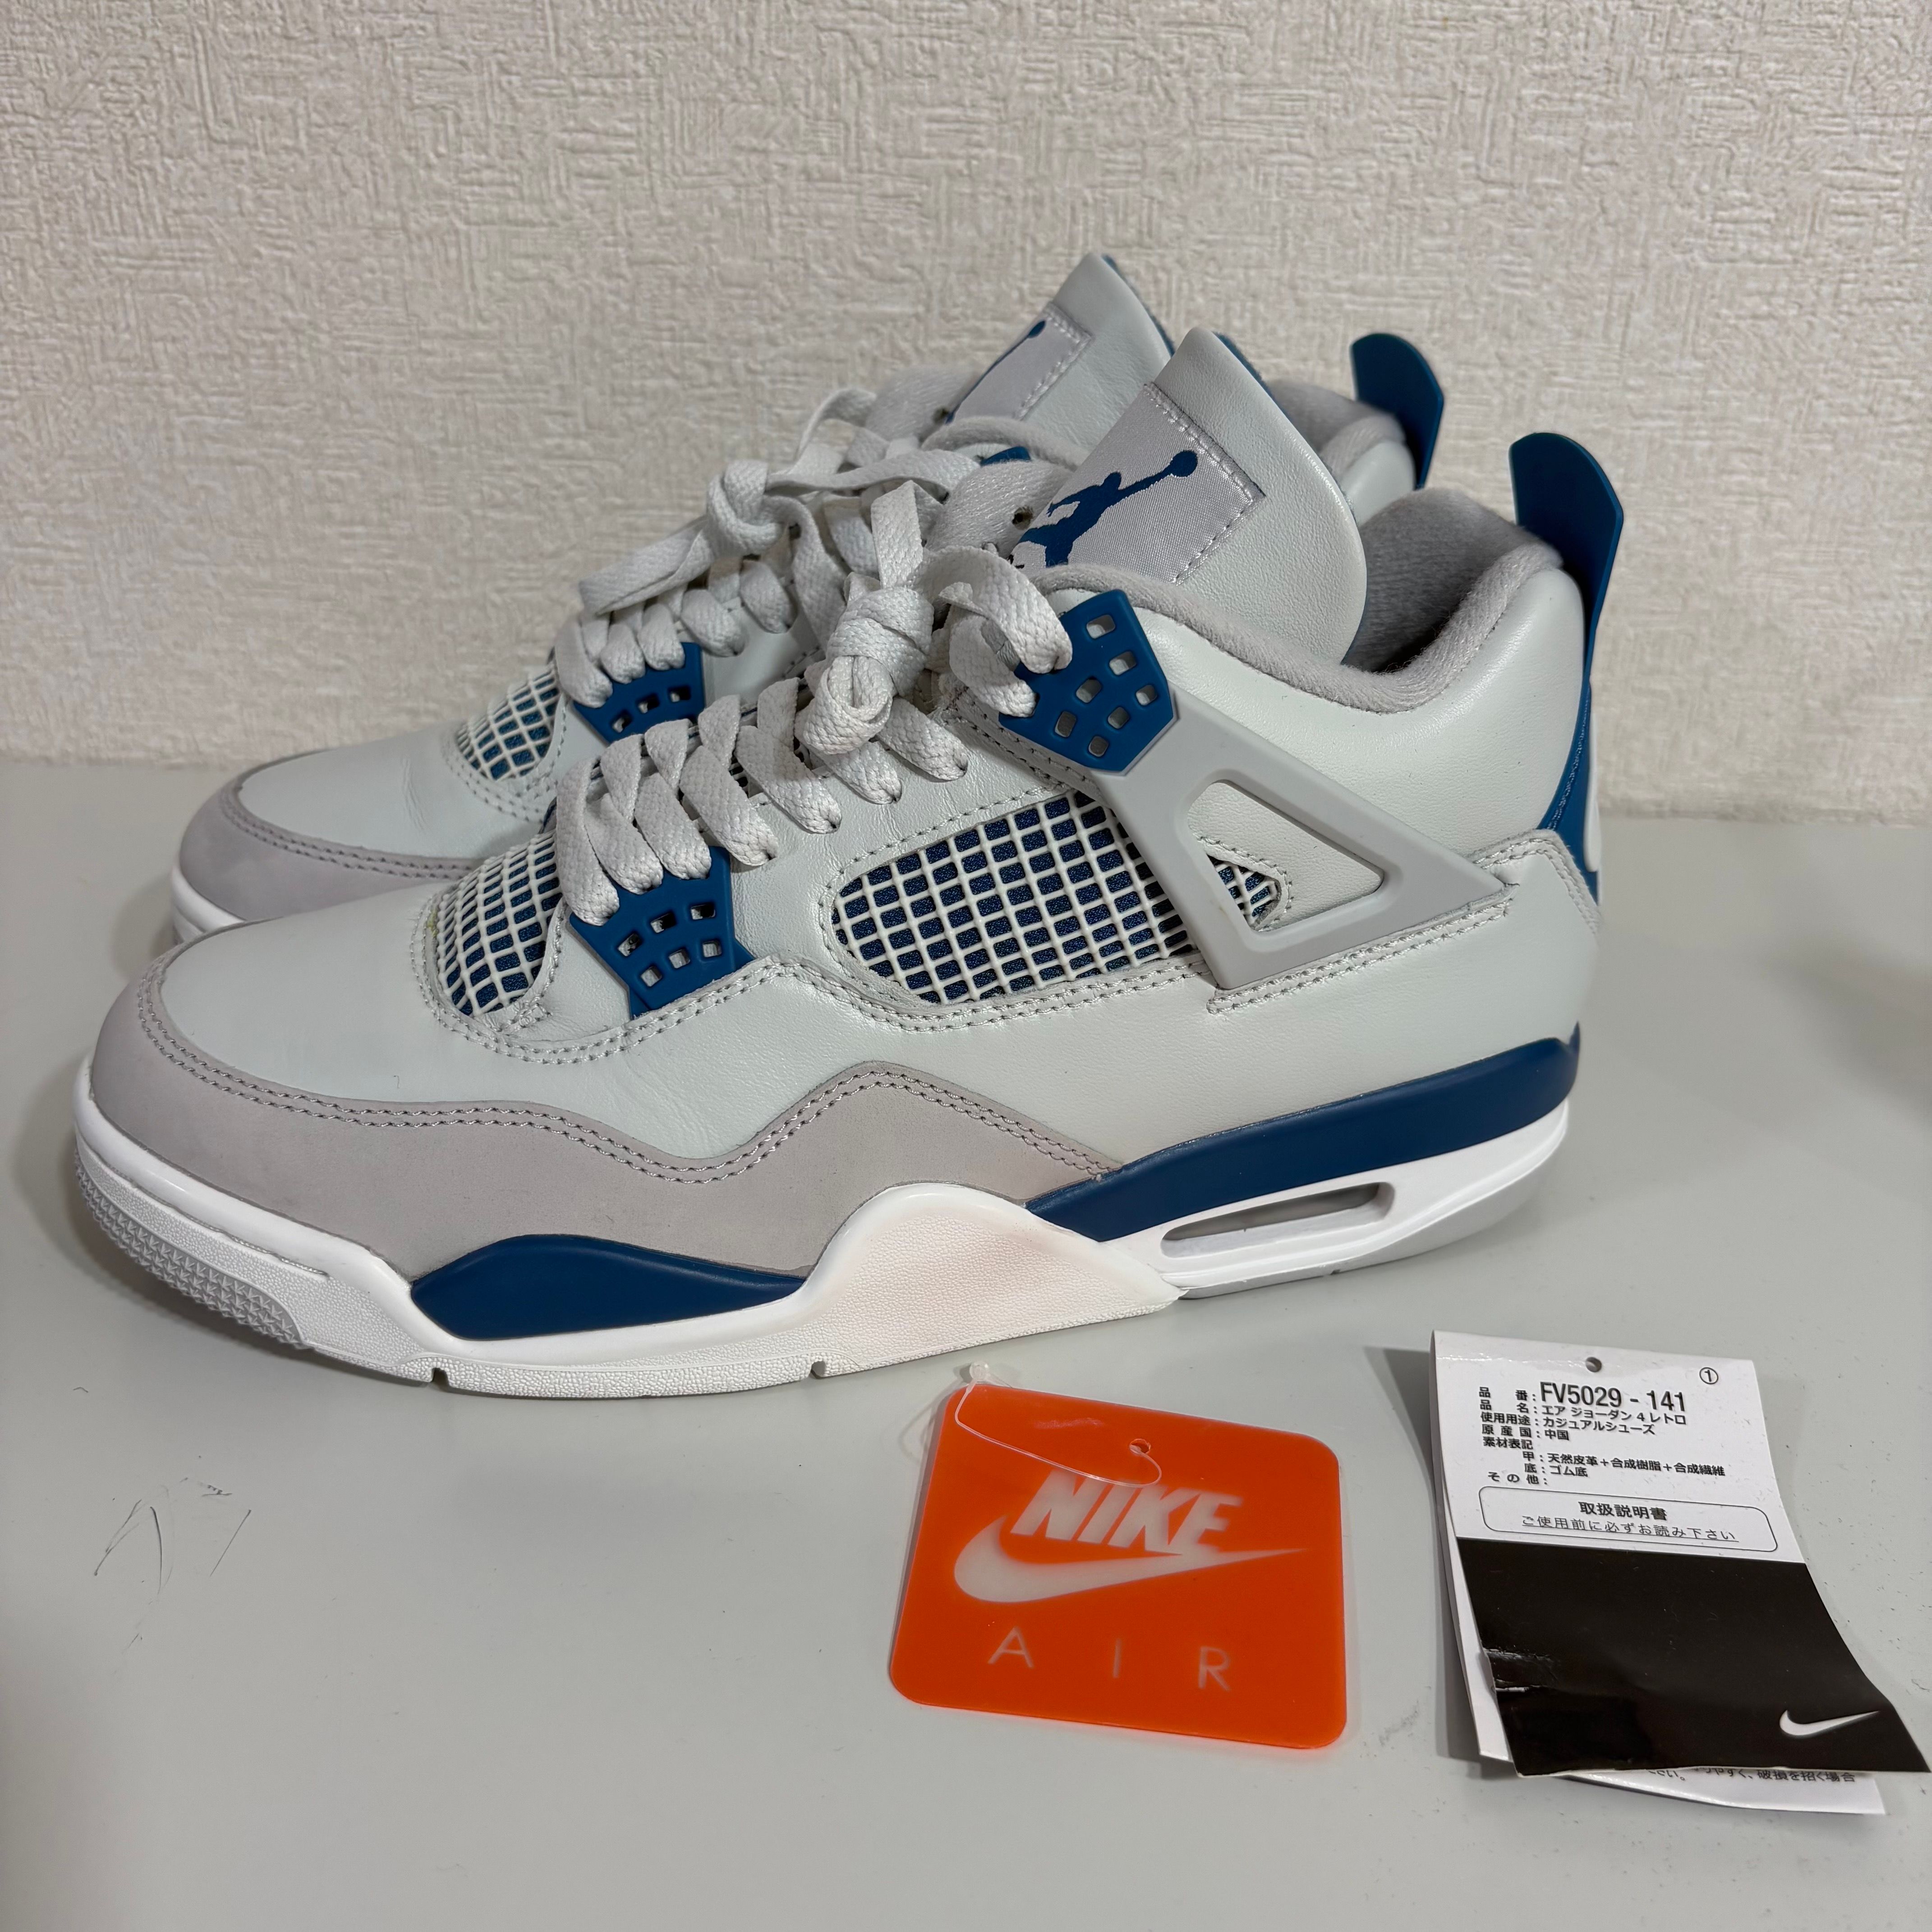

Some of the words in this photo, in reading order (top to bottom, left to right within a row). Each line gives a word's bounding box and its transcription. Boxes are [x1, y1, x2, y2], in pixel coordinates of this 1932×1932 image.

[1483, 1436, 1534, 1450] 素材表記
[1010, 1469, 1243, 1555] NIKE
[1578, 1501, 1668, 1521] 取扱説明書
[1522, 1516, 1736, 1540] ご使用前に必ずお読み下さい
